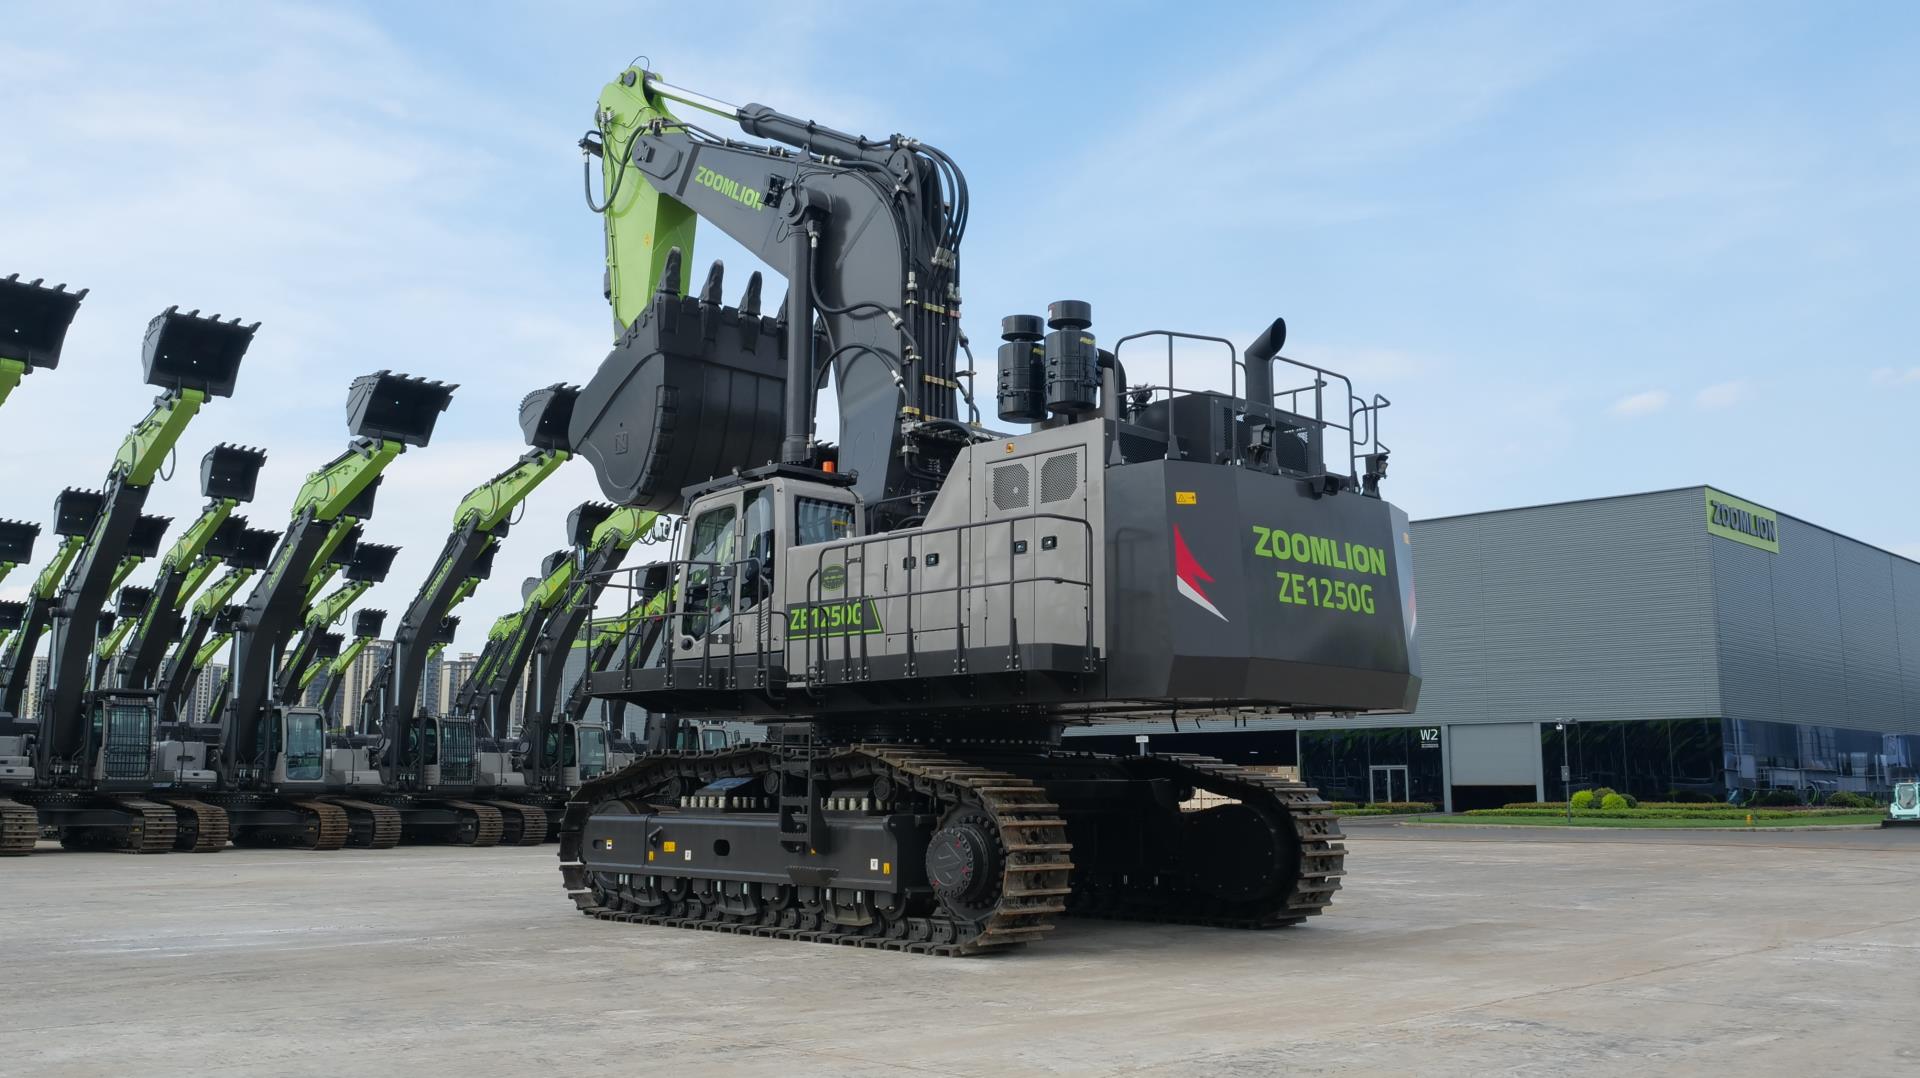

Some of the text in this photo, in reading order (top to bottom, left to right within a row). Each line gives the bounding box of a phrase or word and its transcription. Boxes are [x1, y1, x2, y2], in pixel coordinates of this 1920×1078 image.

[695, 166, 763, 211] ZOOMLION
[1710, 500, 1777, 542] ZOOMLION
[267, 543, 294, 590] ZOOMLION
[1252, 525, 1387, 577] ZOOMLION
[425, 556, 453, 601] ZOOMLION
[1276, 571, 1375, 614] ZE1250G
[1420, 729, 1438, 741] W2
